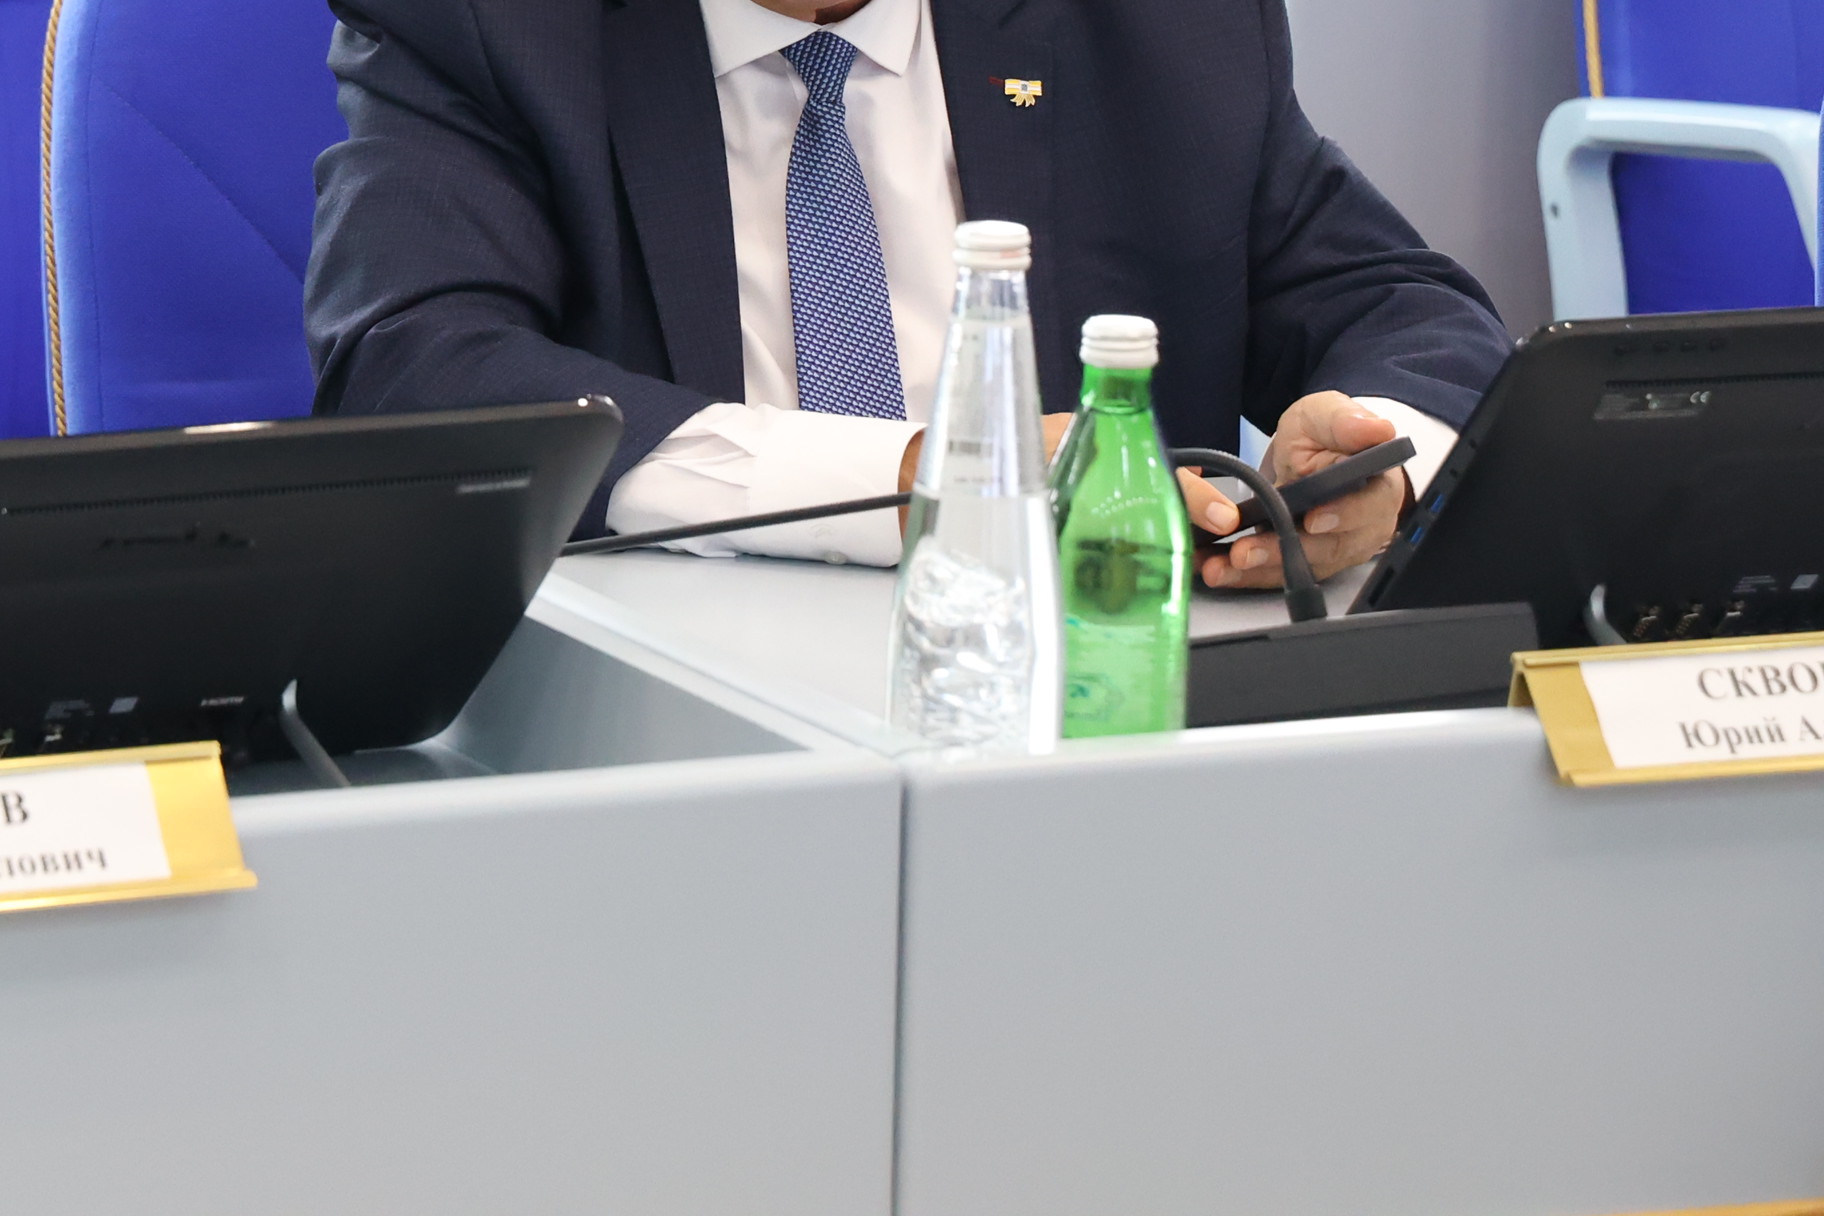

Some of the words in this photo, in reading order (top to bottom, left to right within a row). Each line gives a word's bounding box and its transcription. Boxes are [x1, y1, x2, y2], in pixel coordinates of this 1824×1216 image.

[1696, 660, 1824, 701] СКВО
[1678, 715, 1786, 755] Юрий
[1799, 713, 1824, 742] А
